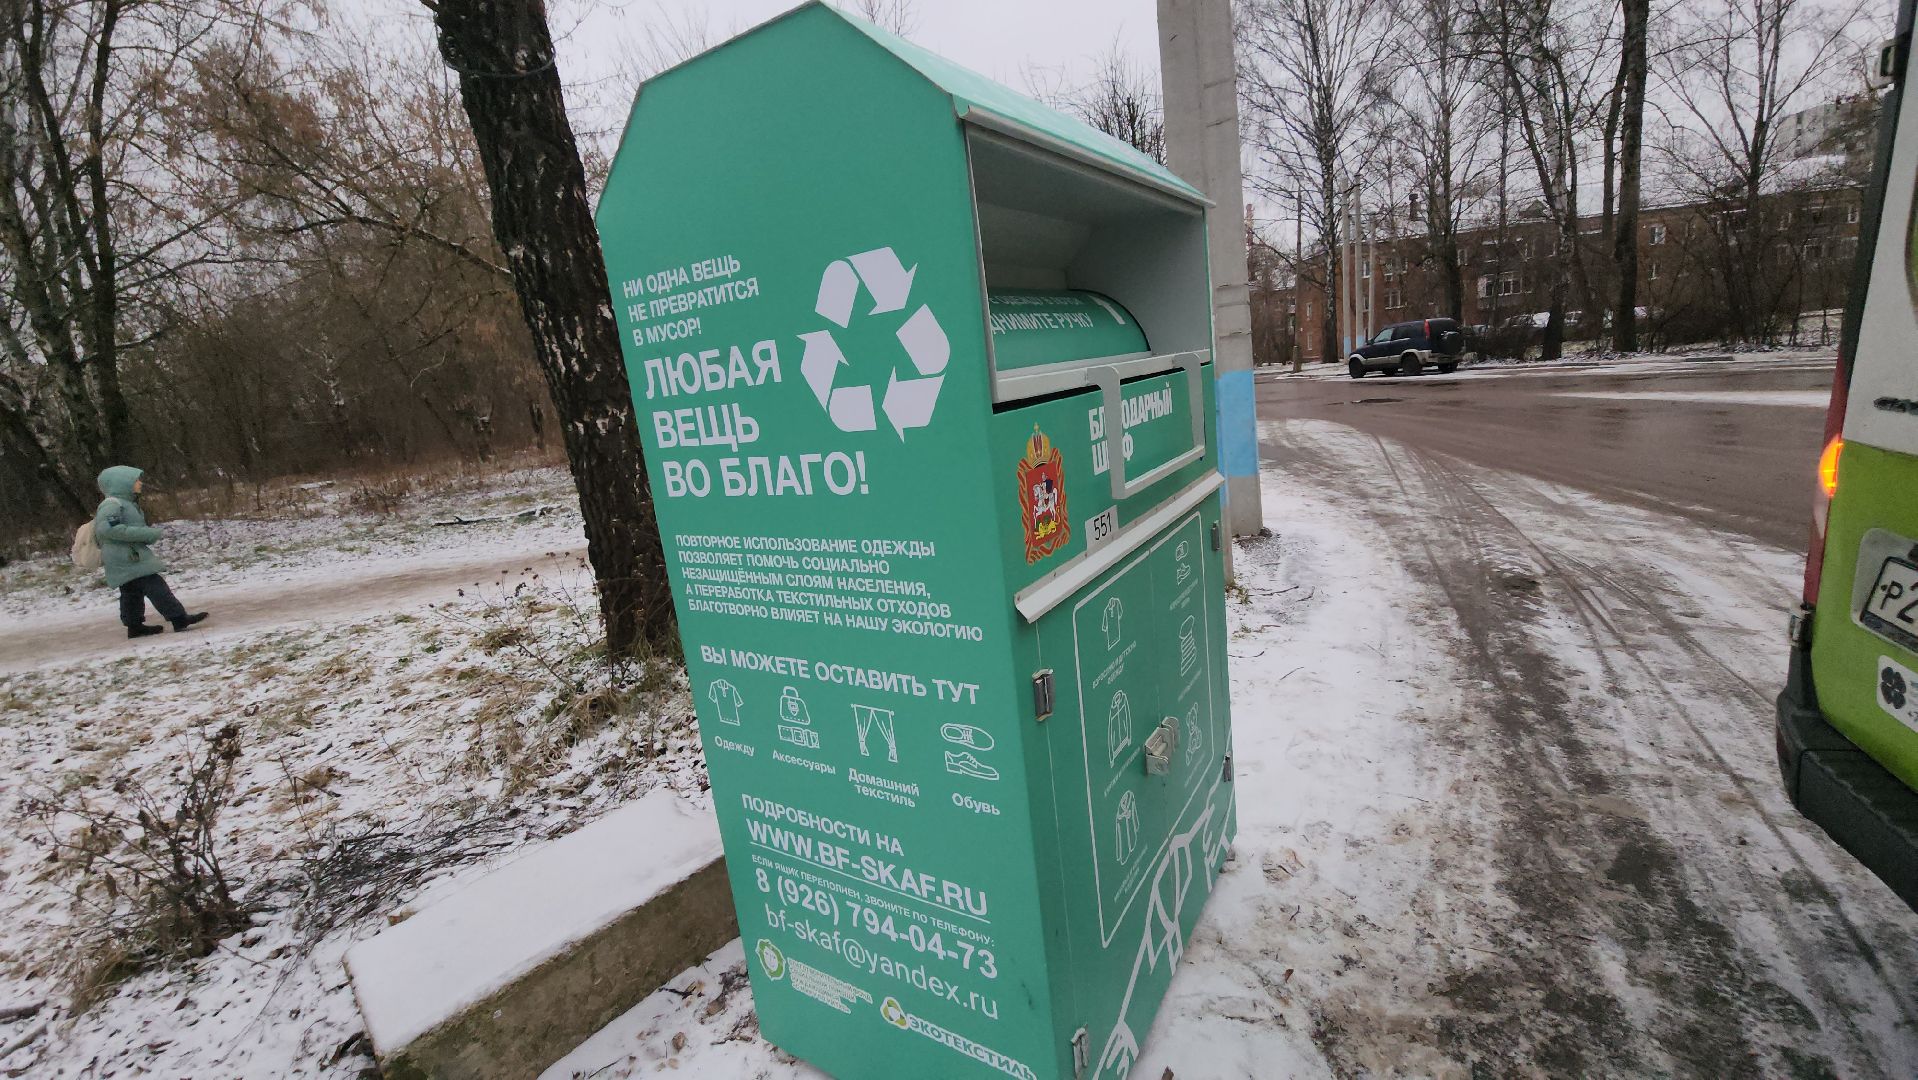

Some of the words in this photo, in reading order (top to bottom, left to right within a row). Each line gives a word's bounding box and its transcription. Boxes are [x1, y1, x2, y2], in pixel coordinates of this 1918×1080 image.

[623, 281, 644, 298] НИ
[646, 265, 689, 294] ОДНА
[692, 254, 741, 283] ВЕЩЬ
[628, 303, 648, 323] НЕ
[650, 277, 759, 318] ПРЕВРАТИТСЯ
[1053, 312, 1093, 328] РУЧКУ
[632, 329, 644, 346] В
[646, 317, 702, 344] МУСОР!
[644, 339, 782, 399] ЛЮБАЯ
[653, 402, 760, 452] ВЕЩЬ
[1088, 381, 1172, 441] БЛОДАРНЫЙ
[662, 459, 711, 497] ВО
[720, 451, 869, 497] БЛАГО!
[1091, 432, 1134, 476] ШФ
[675, 534, 741, 549] ПОВТОРНОЕ
[743, 536, 857, 554] ИСПОЛЬЗОВАНИЕ
[861, 539, 935, 558] ОДЕЖДЫ
[1093, 513, 1112, 540] 551
[678, 551, 743, 566] ПОЗВОЛЯЕТ
[746, 554, 800, 569] ПОМОЧЬ
[802, 556, 890, 574] СОЦИАЛЬНО
[682, 567, 783, 586] НЕЗАЩИЩЁННЫМ
[786, 574, 833, 589] СЛОЯМ
[838, 578, 931, 598] НАСЕЛЕНИЯ,
[685, 583, 693, 595] А
[694, 584, 774, 602] ПЕРЕРАБОТКА
[776, 590, 874, 611] ТЕКСТИЛЬНЫХ
[877, 599, 951, 618] ОТХОДОВ
[689, 599, 768, 618] БЛАГОТВОРНО
[771, 610, 820, 624] ВЛИЯЕТ
[824, 612, 842, 626] НА
[846, 614, 888, 631] НАШУ
[891, 619, 983, 642] ЭКОЛОГИЮ
[701, 645, 727, 666] ВЫ
[730, 650, 810, 679] МОЖЕТЕ
[815, 662, 926, 697] ОСТАВИТЬ
[932, 679, 980, 705] ТУТ
[714, 736, 754, 757] Одежду
[772, 750, 836, 775] Аксессуары
[848, 768, 920, 797] Домашний
[855, 784, 916, 808] текстиль
[952, 793, 1001, 816] Обувь
[741, 794, 870, 846] ПОДРОБНОСТИ
[876, 829, 904, 856] НА
[746, 818, 988, 916] WWW.BF-SKAF.RU
[752, 854, 773, 868] ЕСЛИ
[775, 862, 800, 878] ЯЩИК
[801, 871, 863, 901] ПЕРЕПОЛНЕН,
[865, 894, 911, 917] ЗВОНИТЕ
[912, 911, 928, 923] ПО
[930, 916, 995, 947] ТЕЛЕФОНУ:
[756, 868, 770, 892] 8
[778, 875, 839, 926] (926)
[846, 901, 998, 979] 794-04-73
[765, 903, 999, 1020] bf-skaf@yandex.ru
[909, 1016, 1035, 1080] ЭКОТЕКСТИЛЬ
